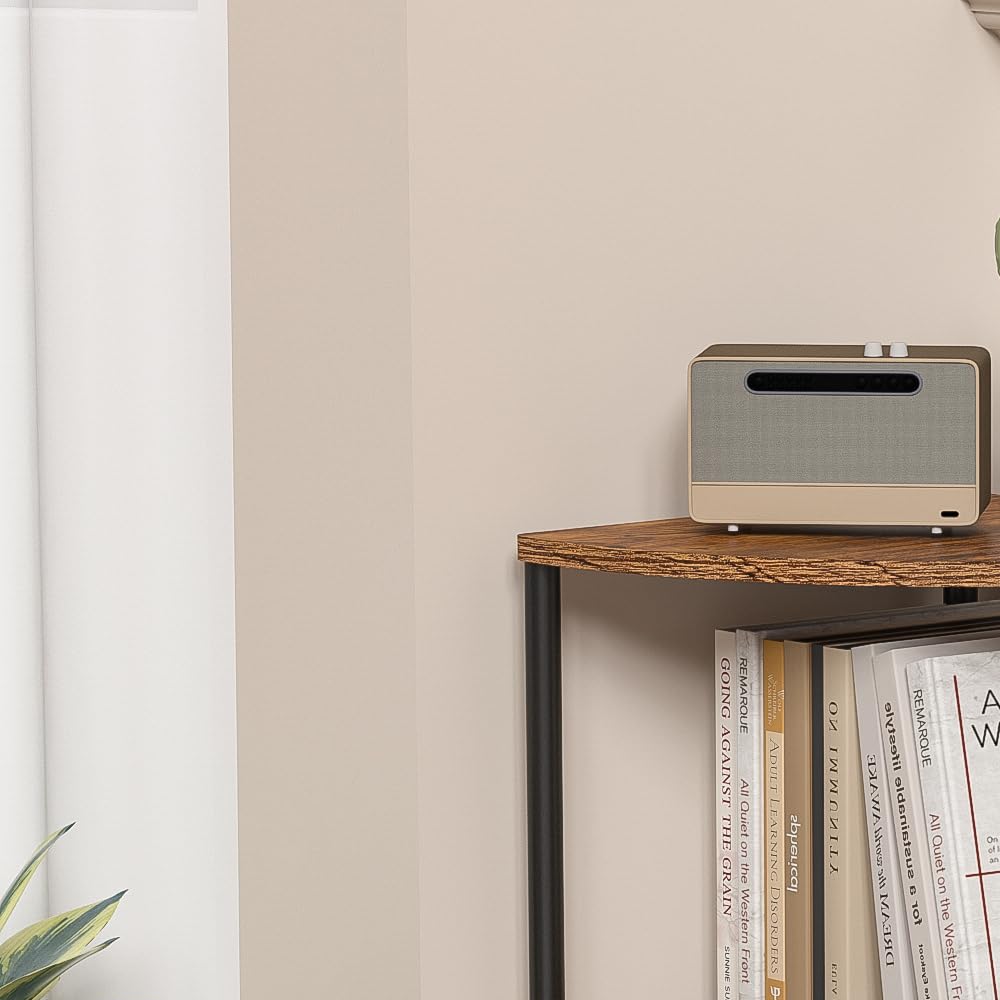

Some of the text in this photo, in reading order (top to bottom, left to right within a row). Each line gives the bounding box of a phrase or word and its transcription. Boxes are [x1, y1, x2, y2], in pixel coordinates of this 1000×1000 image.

[739, 657, 749, 734] REMARQUE
[913, 689, 932, 768] REMARQUE
[720, 657, 732, 916] GOING AGAINST THE GRAIN
[929, 813, 941, 832] All
[987, 836, 998, 844] On
[740, 779, 750, 984] All Quiet on the Western Front
[769, 739, 780, 974] ADULT LEARNING DISORDERS
[932, 834, 945, 873] Quiet
[938, 878, 947, 894] on
[941, 898, 951, 921] the
[943, 923, 958, 983] Western
